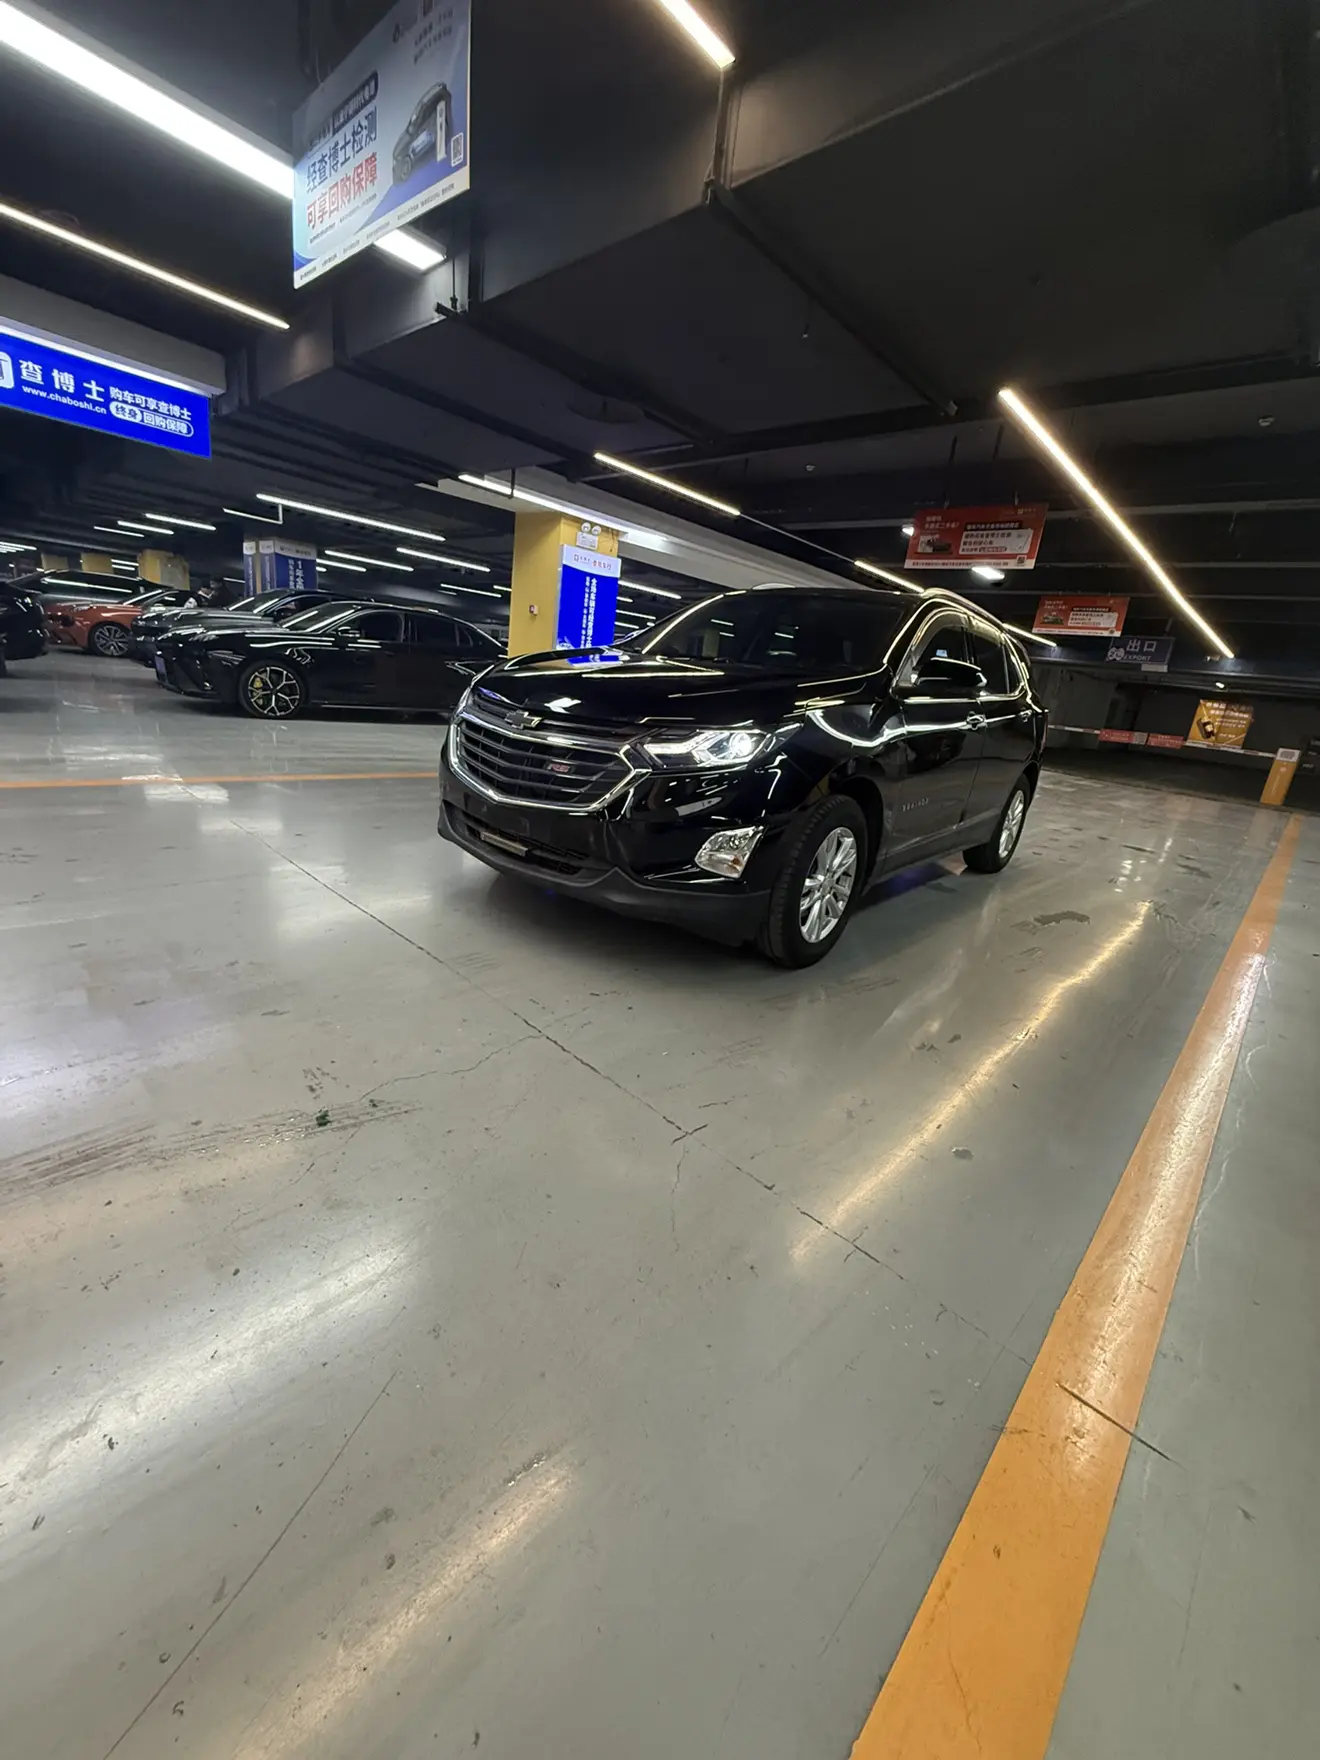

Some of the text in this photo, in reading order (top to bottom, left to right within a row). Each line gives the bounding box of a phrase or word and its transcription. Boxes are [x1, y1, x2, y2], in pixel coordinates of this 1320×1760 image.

[306, 105, 378, 193] 经查博士检测
[306, 151, 378, 230] 可享回购保障
[18, 359, 105, 403] 查博士
[22, 385, 107, 415] www.chaboshi.cn
[109, 386, 192, 421] 购车可享查博士
[1126, 639, 1157, 652] 出口
